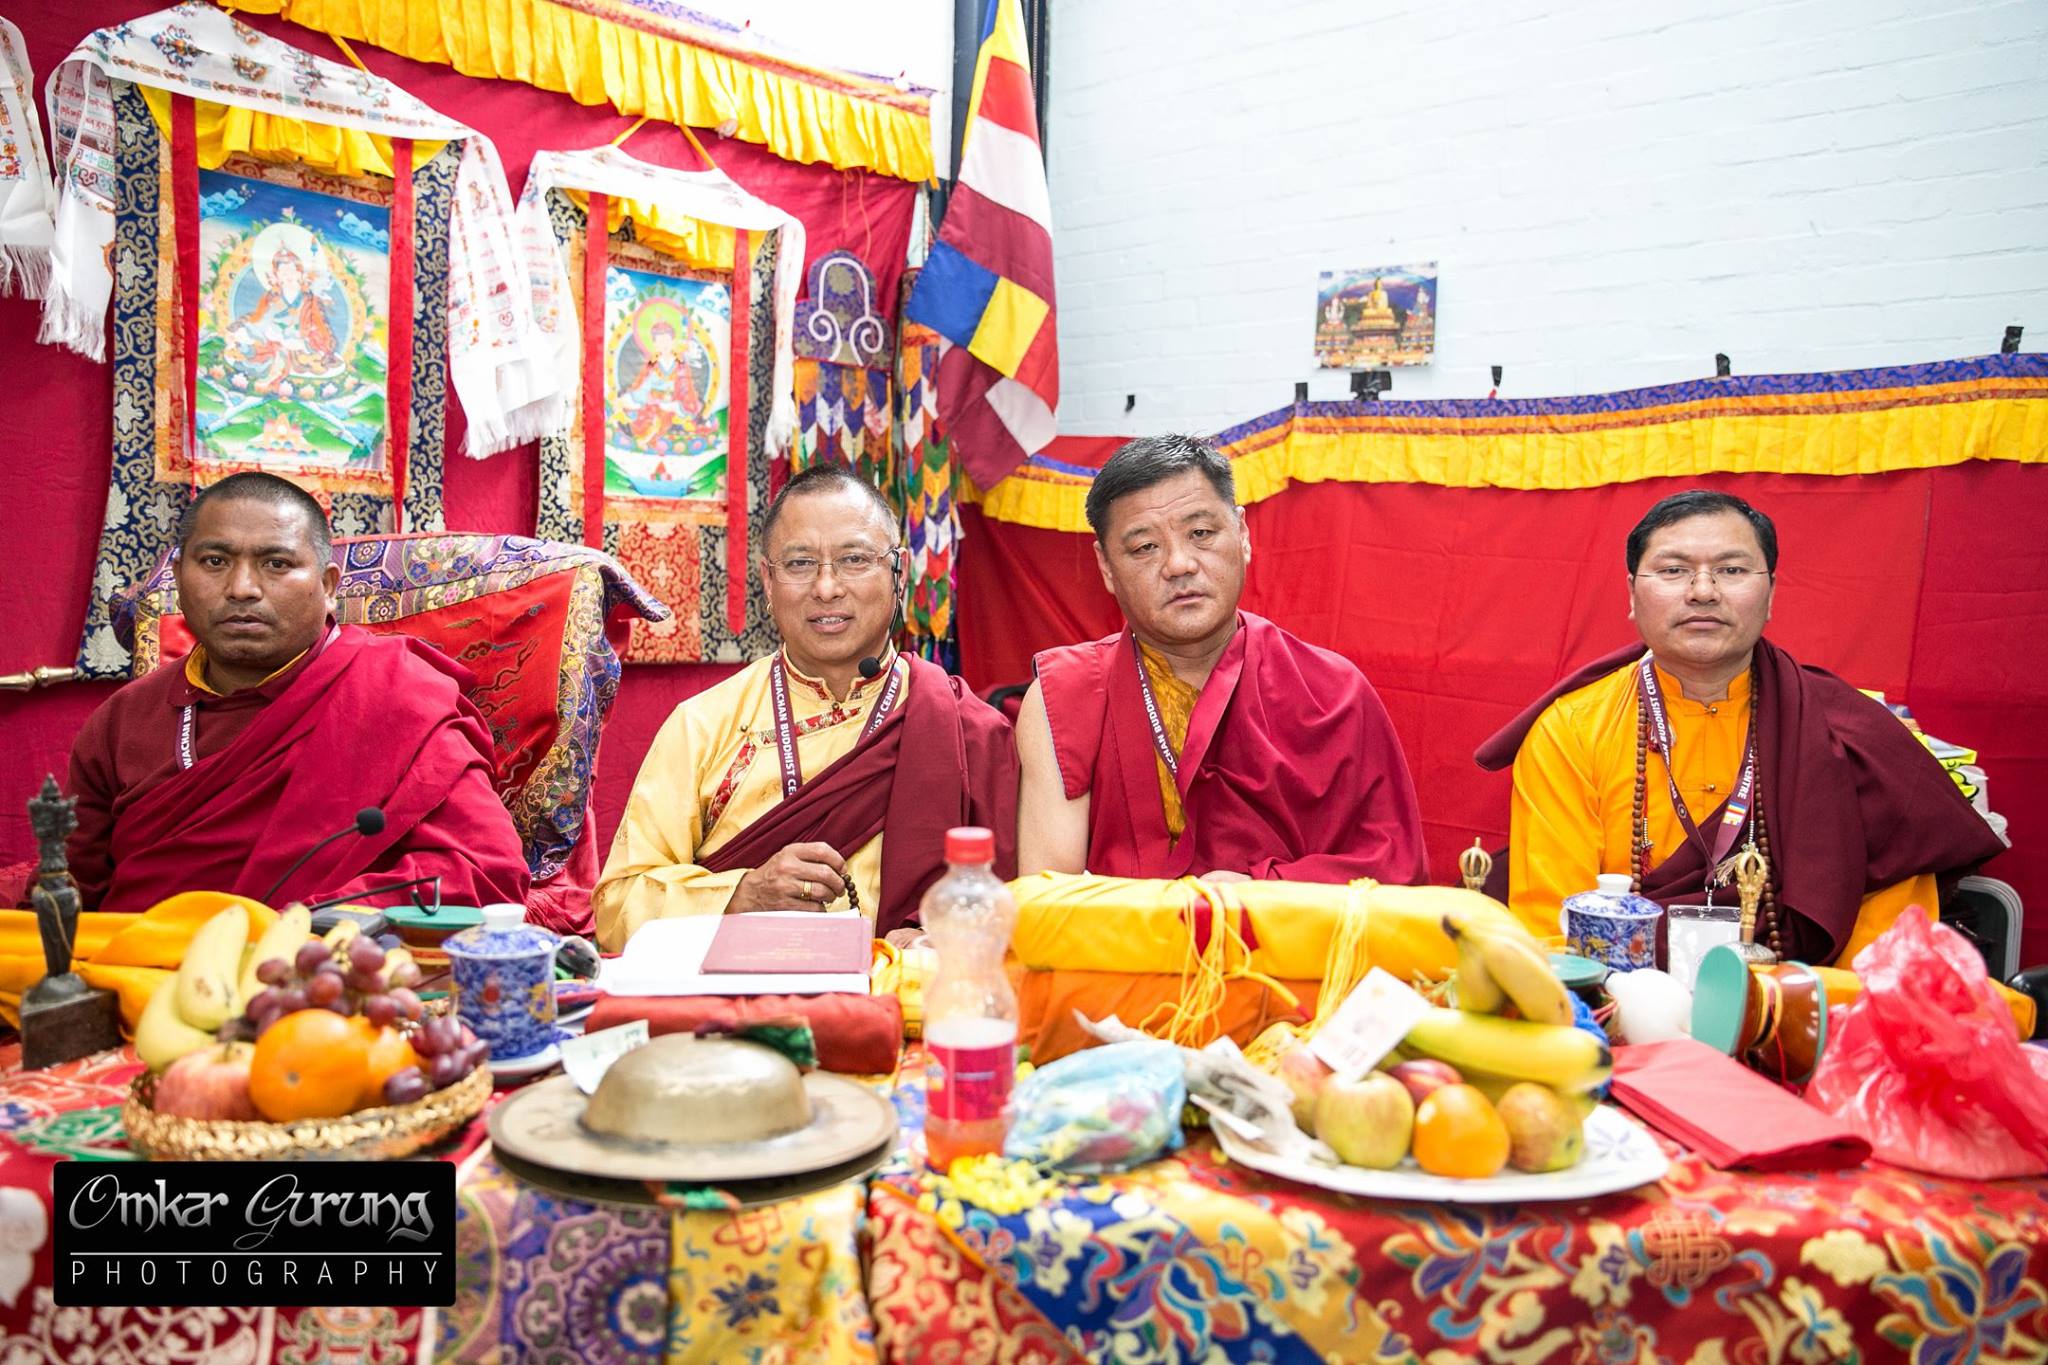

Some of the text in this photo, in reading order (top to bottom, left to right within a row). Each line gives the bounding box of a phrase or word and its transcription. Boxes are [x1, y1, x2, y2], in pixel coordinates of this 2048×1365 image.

[880, 674, 899, 712] CENTRE
[773, 664, 797, 796] DEWACHAN BUDDHIST CE
[1649, 696, 1667, 743] BUDDHIST
[1157, 732, 1178, 773] ACHAN
